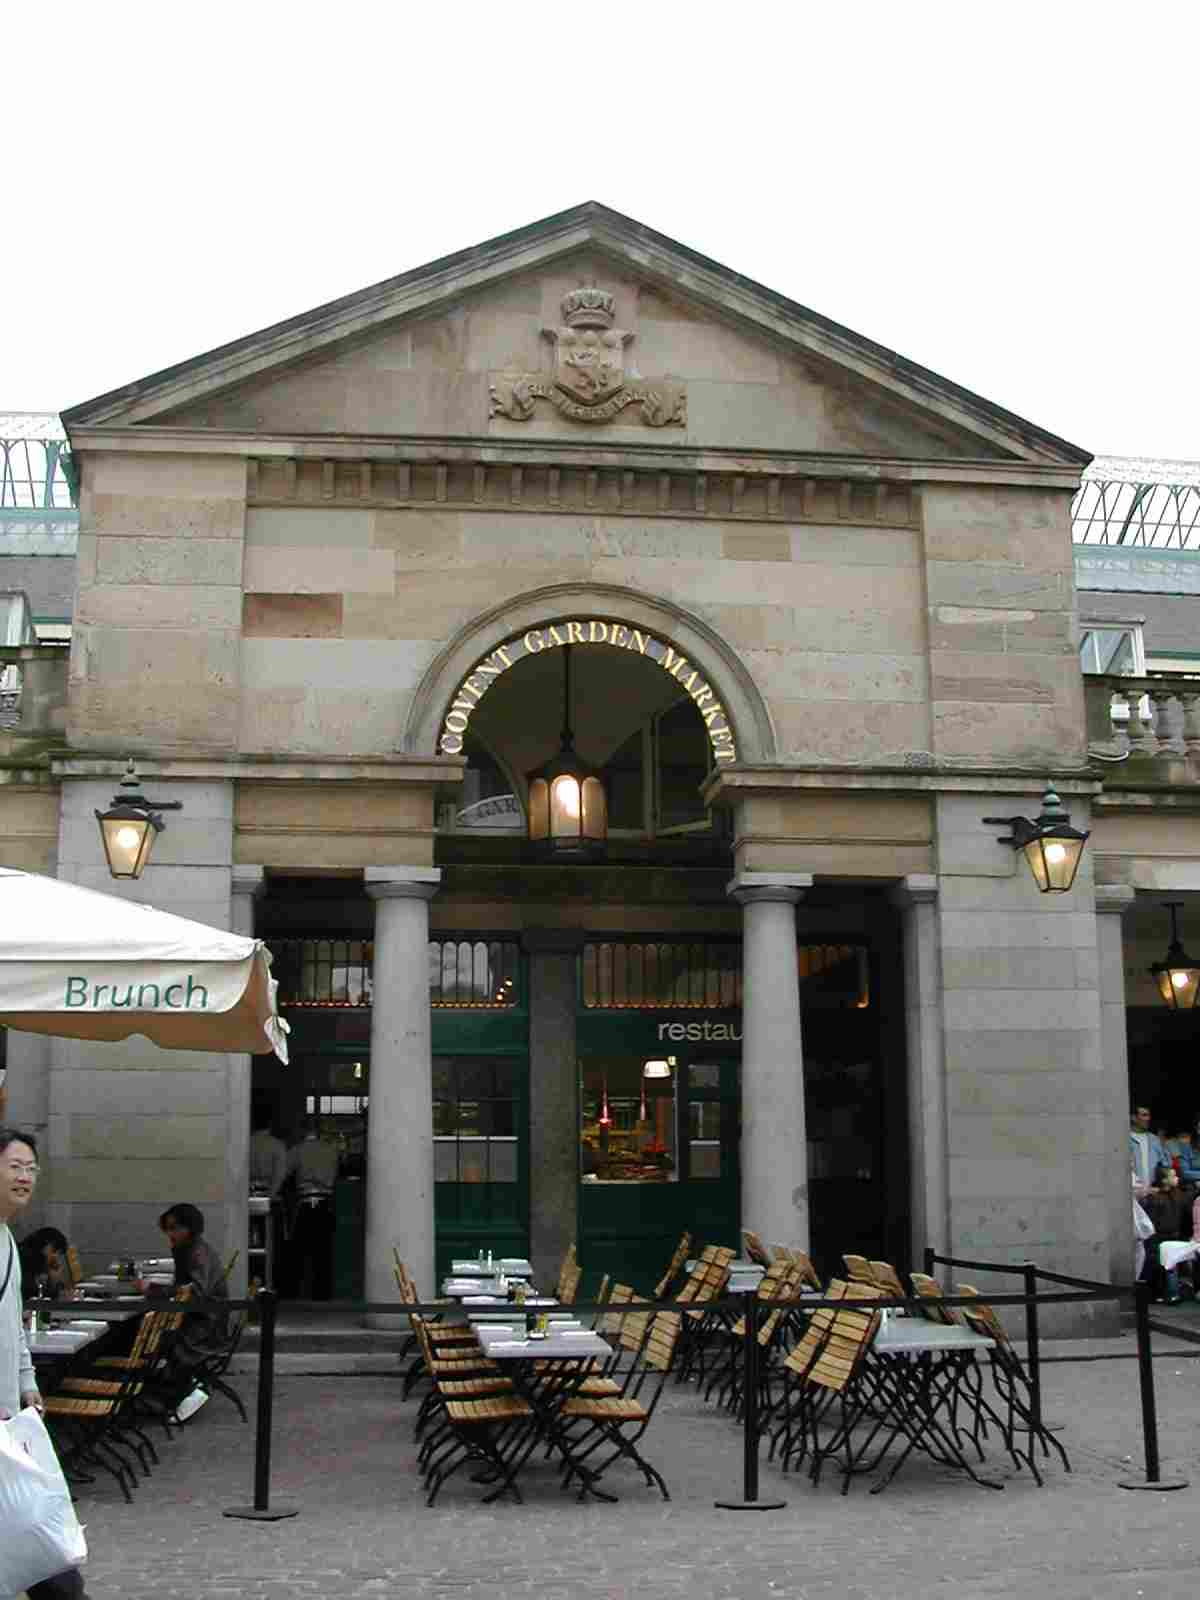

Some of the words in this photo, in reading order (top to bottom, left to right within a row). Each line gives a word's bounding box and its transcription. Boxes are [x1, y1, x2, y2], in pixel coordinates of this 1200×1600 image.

[440, 646, 513, 754] COVENT
[524, 621, 650, 654] GARDEN
[658, 647, 737, 763] MARKET
[65, 975, 208, 1008] Brunch
